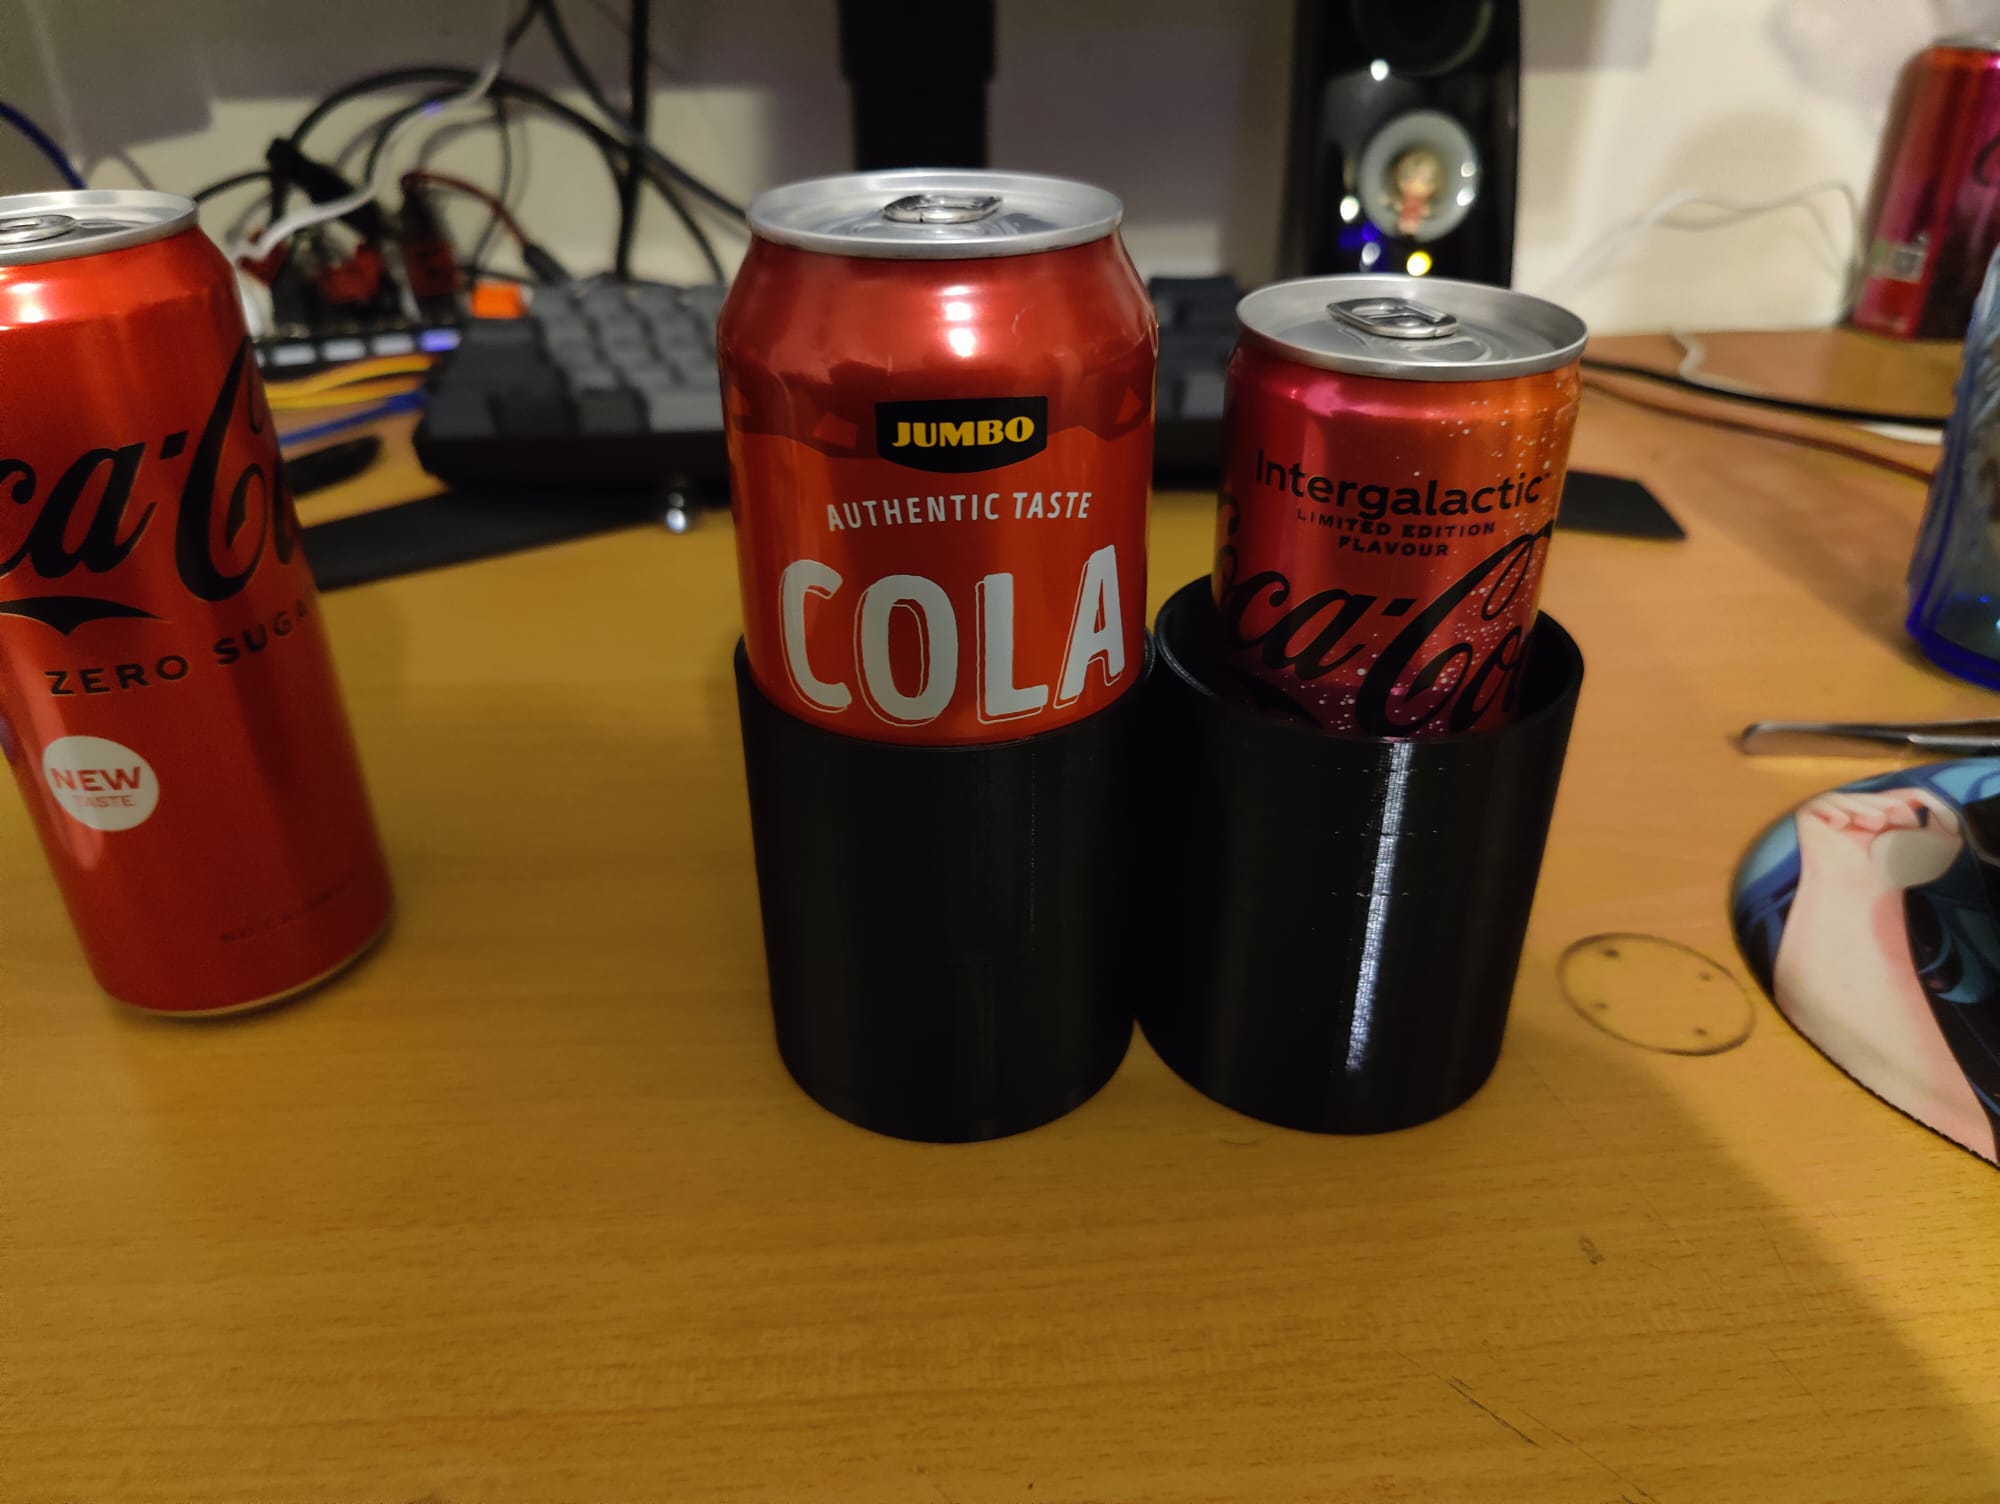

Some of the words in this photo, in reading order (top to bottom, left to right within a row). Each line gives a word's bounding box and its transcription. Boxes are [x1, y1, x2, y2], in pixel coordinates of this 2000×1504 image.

[892, 416, 1035, 448] JUMBO
[1255, 448, 1543, 520] Intergalactic
[827, 493, 1000, 532] AUTHENTIC
[1012, 491, 1093, 520] TASTE
[1297, 509, 1391, 537] LIMITED
[1401, 522, 1496, 539] EDITION
[1338, 535, 1449, 557] FLAVOUR
[44, 654, 190, 696] ZERO
[213, 599, 309, 665] SUGA
[778, 544, 1126, 727] COLA
[50, 766, 141, 792] NEW
